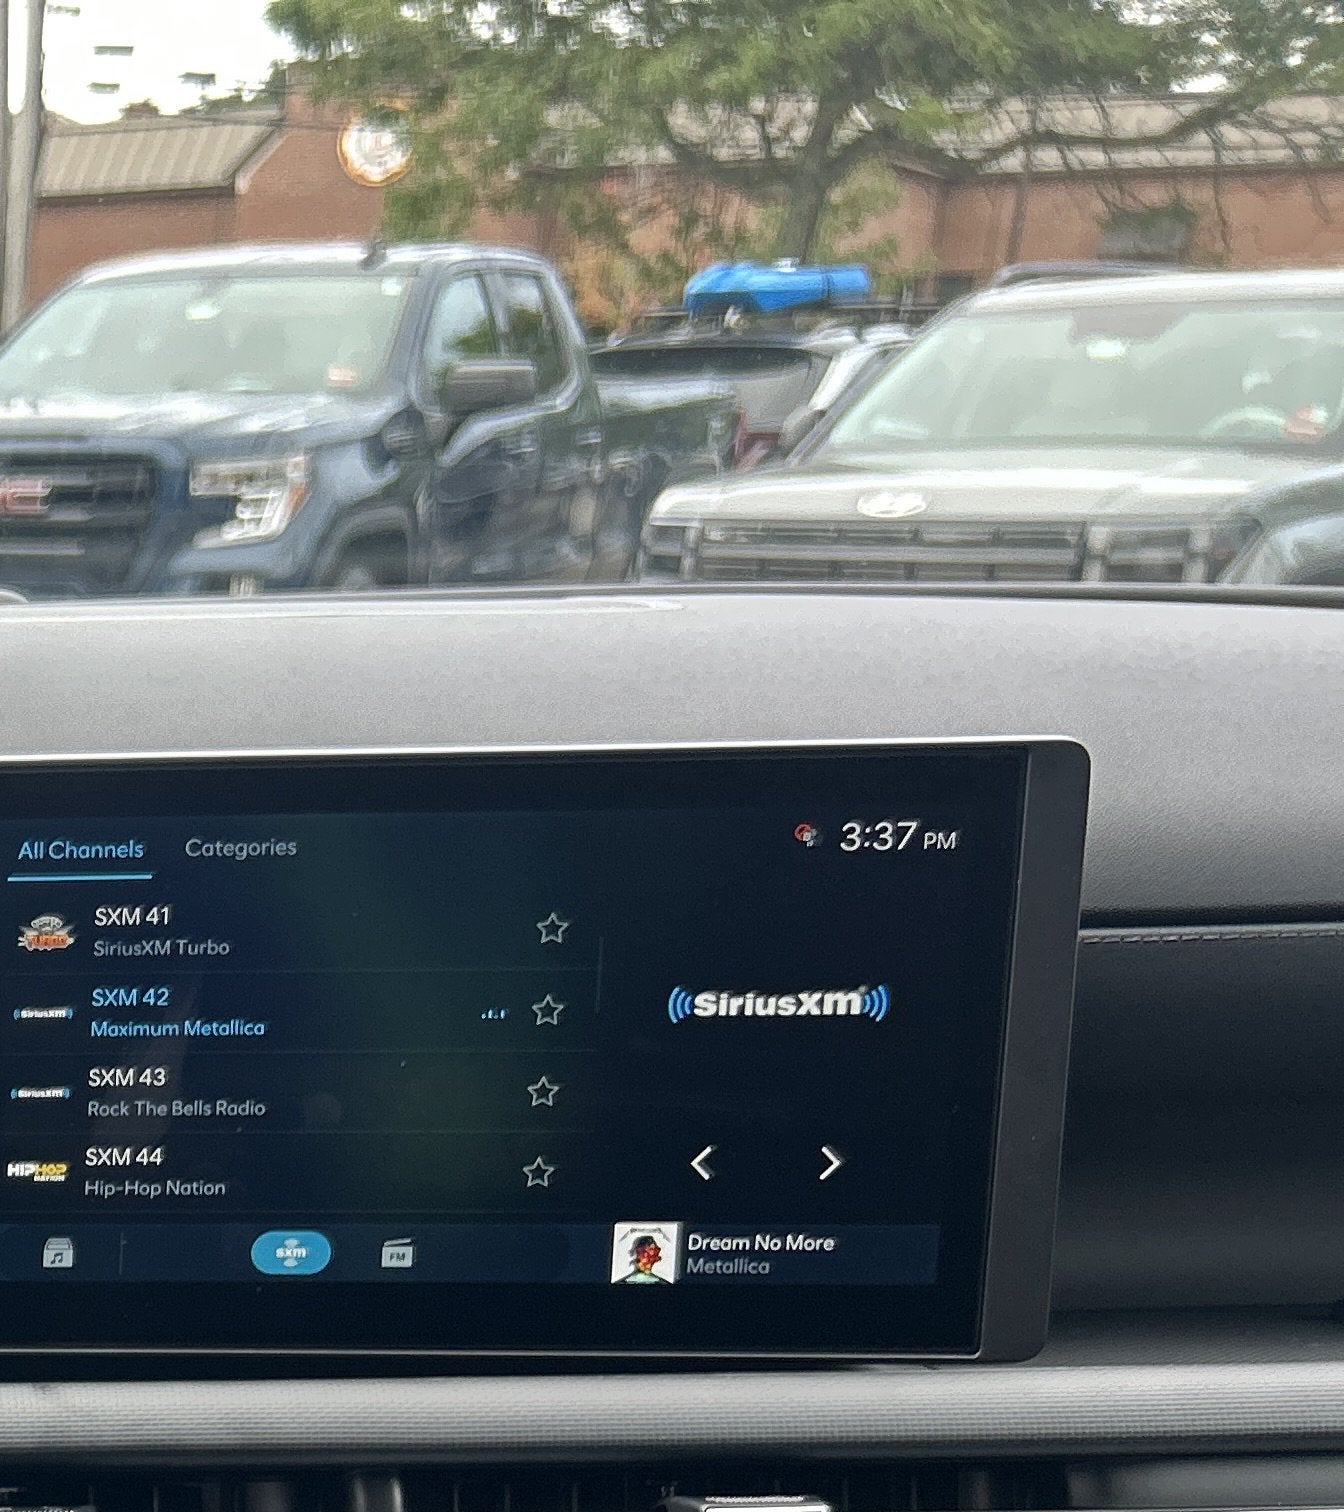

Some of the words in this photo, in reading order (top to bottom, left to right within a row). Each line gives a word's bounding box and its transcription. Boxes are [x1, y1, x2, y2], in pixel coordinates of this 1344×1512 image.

[839, 821, 918, 852] 3:37
[923, 831, 957, 850] PM
[18, 840, 46, 860] All
[48, 838, 145, 860] Channels
[184, 836, 298, 862] Categories
[94, 906, 142, 926] SXM
[146, 905, 170, 925] 41
[93, 938, 171, 957] SiriusXM
[175, 938, 231, 957] Turbo
[91, 987, 138, 1007] SXM
[142, 987, 169, 1006] 42
[90, 1019, 178, 1037] Maximum
[184, 1018, 265, 1038] Metallica
[88, 1067, 135, 1087] SXM
[139, 1067, 166, 1087] 43
[87, 1099, 129, 1118] Rock
[133, 1099, 167, 1118] The
[171, 1099, 210, 1118] Bells
[216, 1099, 266, 1118] Radio
[85, 1147, 132, 1166] SXM
[136, 1147, 164, 1166] 44
[84, 1179, 160, 1200] Hip-Hop
[166, 1178, 226, 1197] Nation
[275, 1247, 307, 1258] sxm
[687, 1234, 750, 1252] Dream
[755, 1234, 782, 1252] No
[786, 1234, 835, 1252] More
[389, 1253, 406, 1262] FM
[686, 1257, 770, 1276] Metallica
